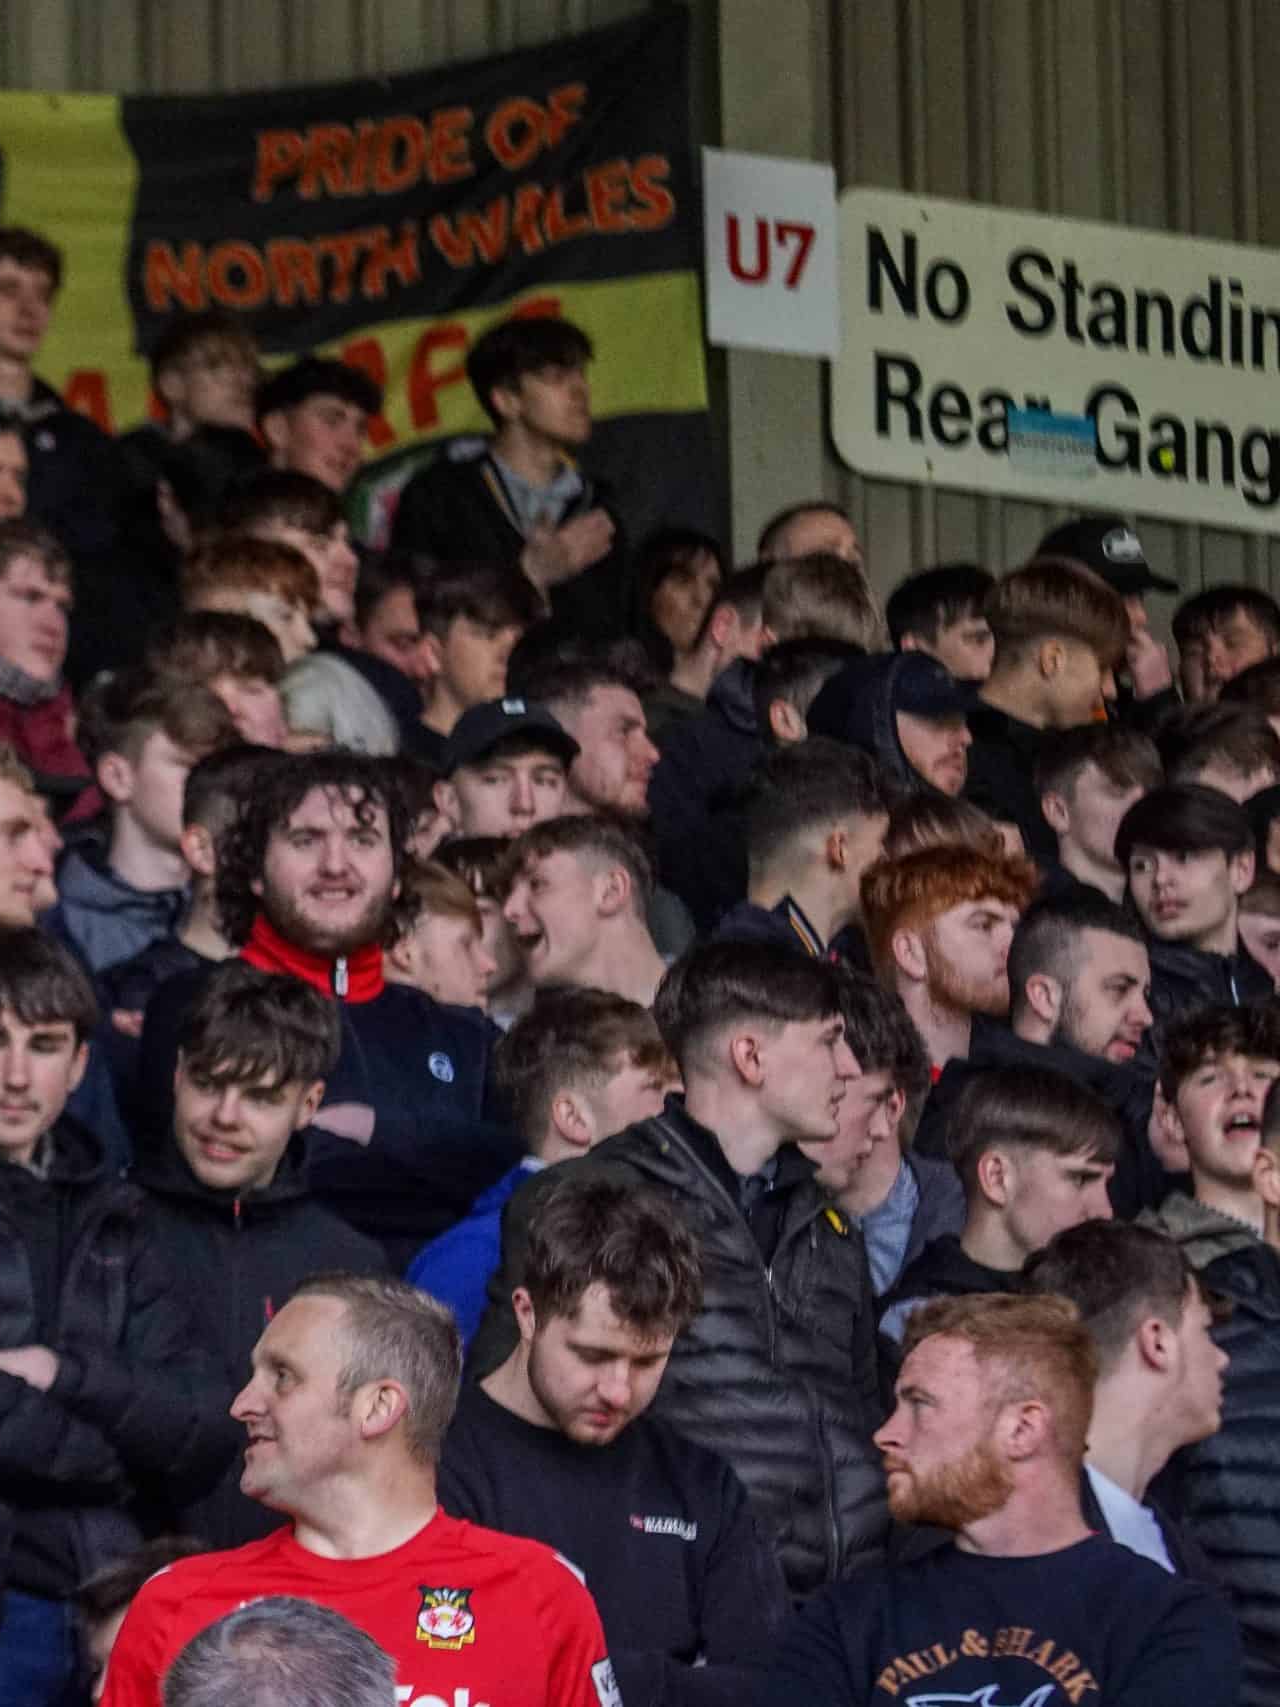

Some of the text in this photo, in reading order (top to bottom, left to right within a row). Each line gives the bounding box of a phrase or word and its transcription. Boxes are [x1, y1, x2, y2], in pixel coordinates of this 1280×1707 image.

[252, 83, 589, 201] PRIDE OF
[144, 156, 675, 311] NORTH WALES
[724, 211, 816, 290] U7
[864, 223, 970, 324] No
[873, 350, 1051, 455] Rea
[875, 1626, 1100, 1705] PAUL & SHARK
